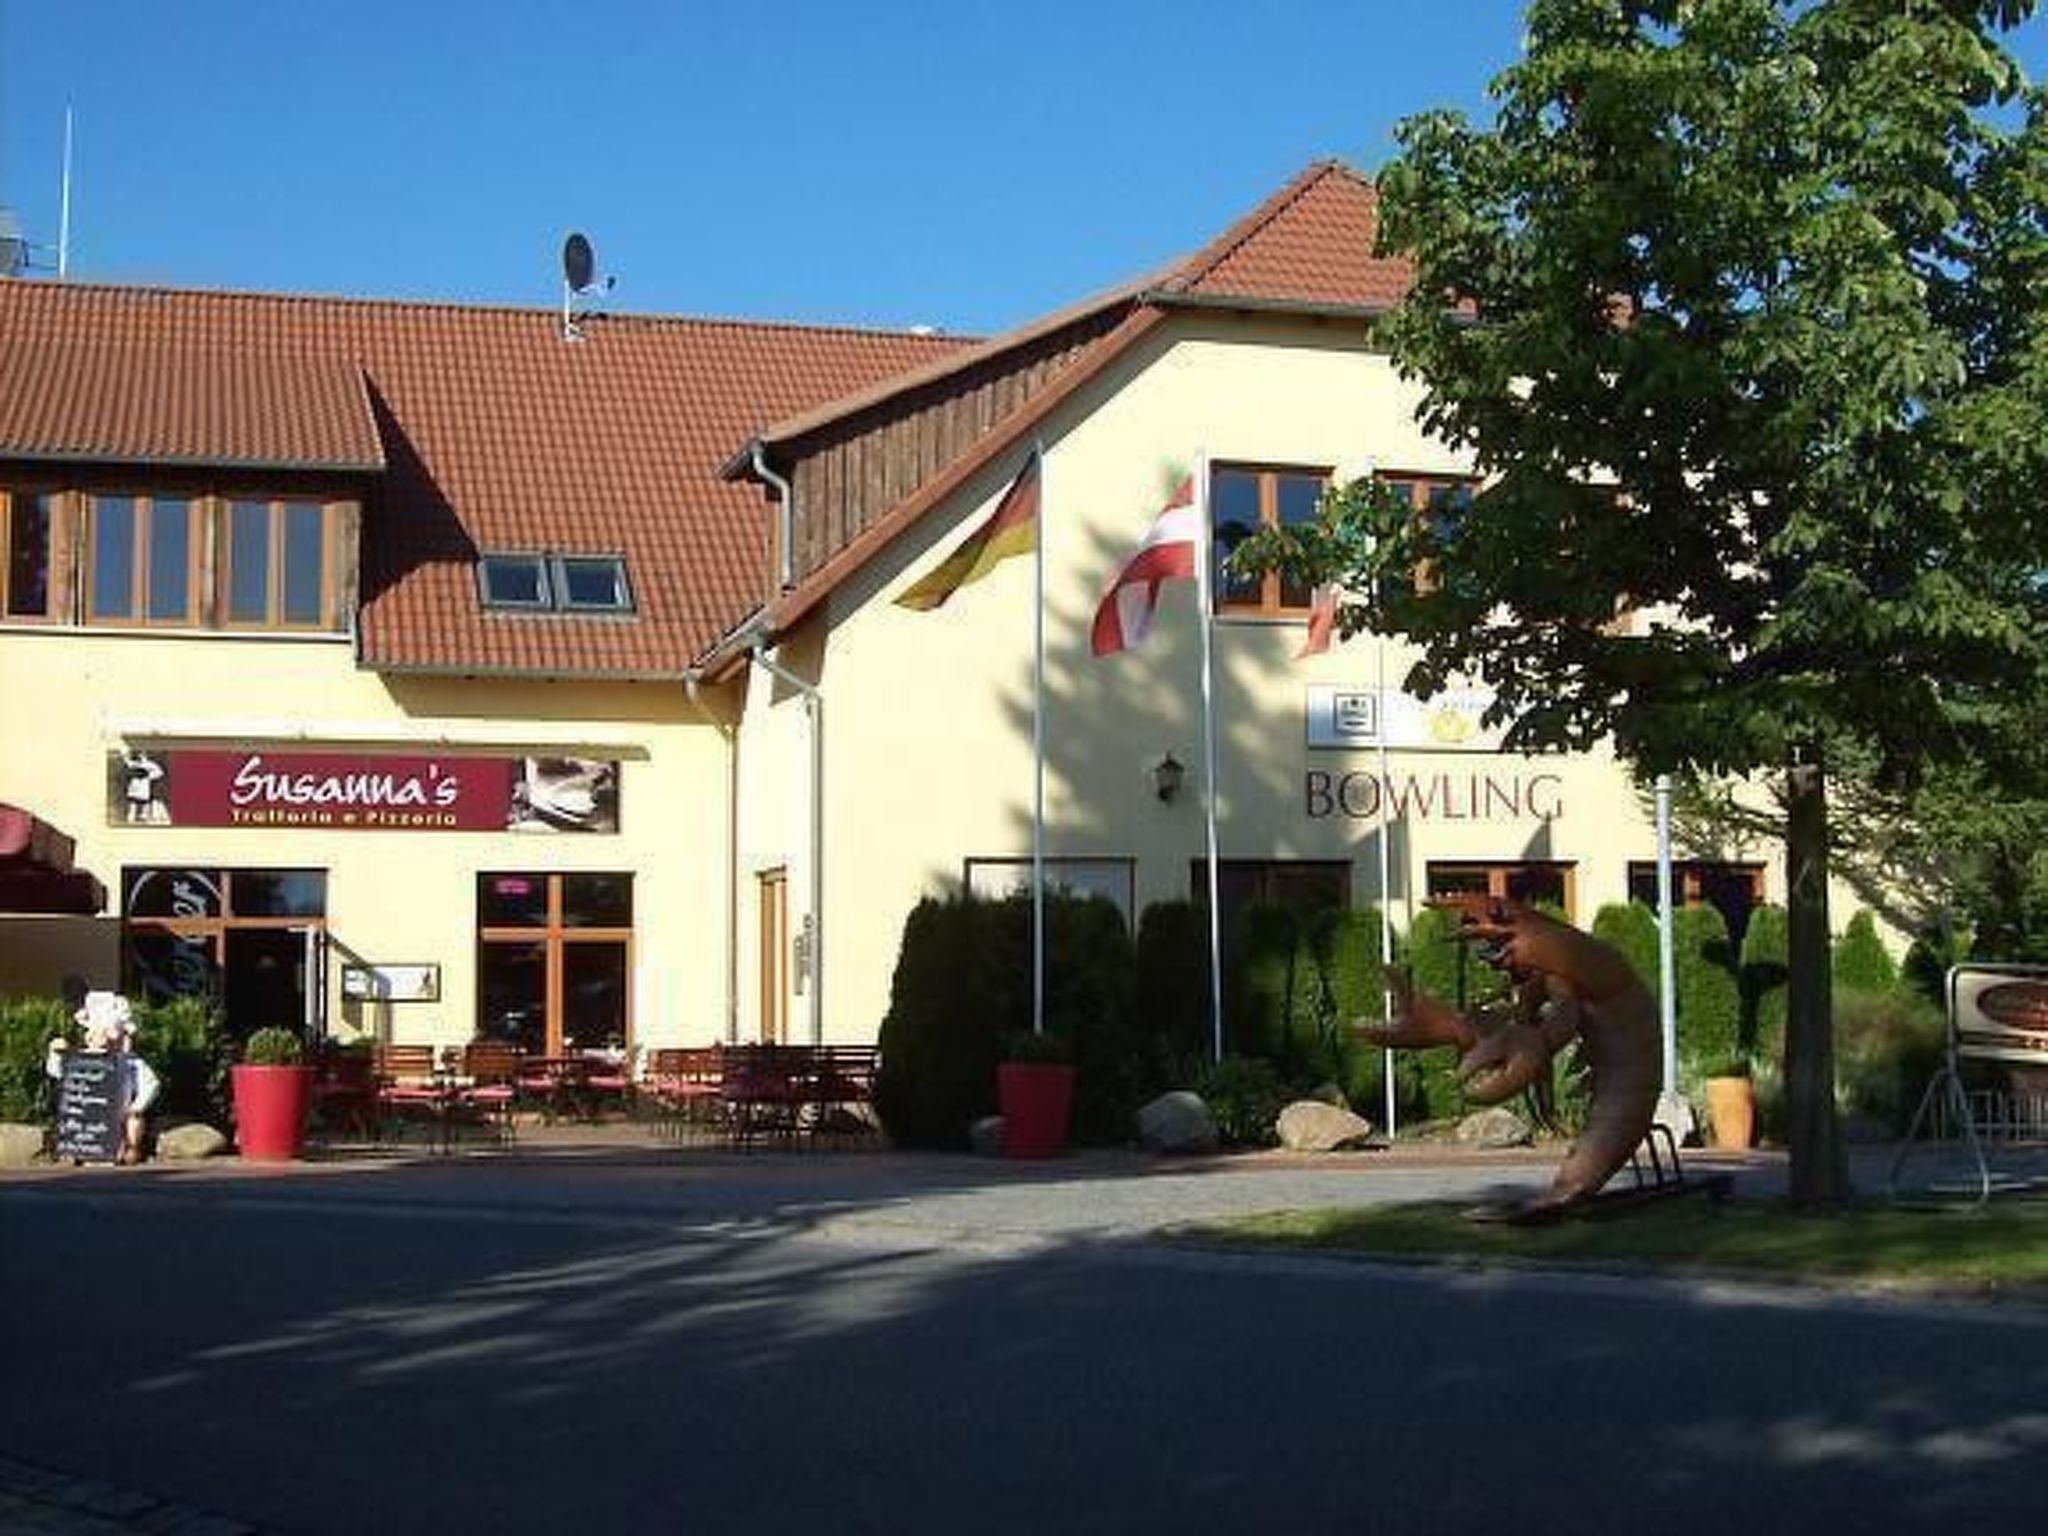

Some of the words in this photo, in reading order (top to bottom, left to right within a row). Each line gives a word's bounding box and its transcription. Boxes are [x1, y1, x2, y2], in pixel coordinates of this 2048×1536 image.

[230, 756, 458, 805] Susanna's
[1306, 770, 1563, 820] BOWLING
[230, 809, 333, 824] Trattoria
[343, 812, 356, 824] e
[366, 810, 457, 826] Pizzeria
